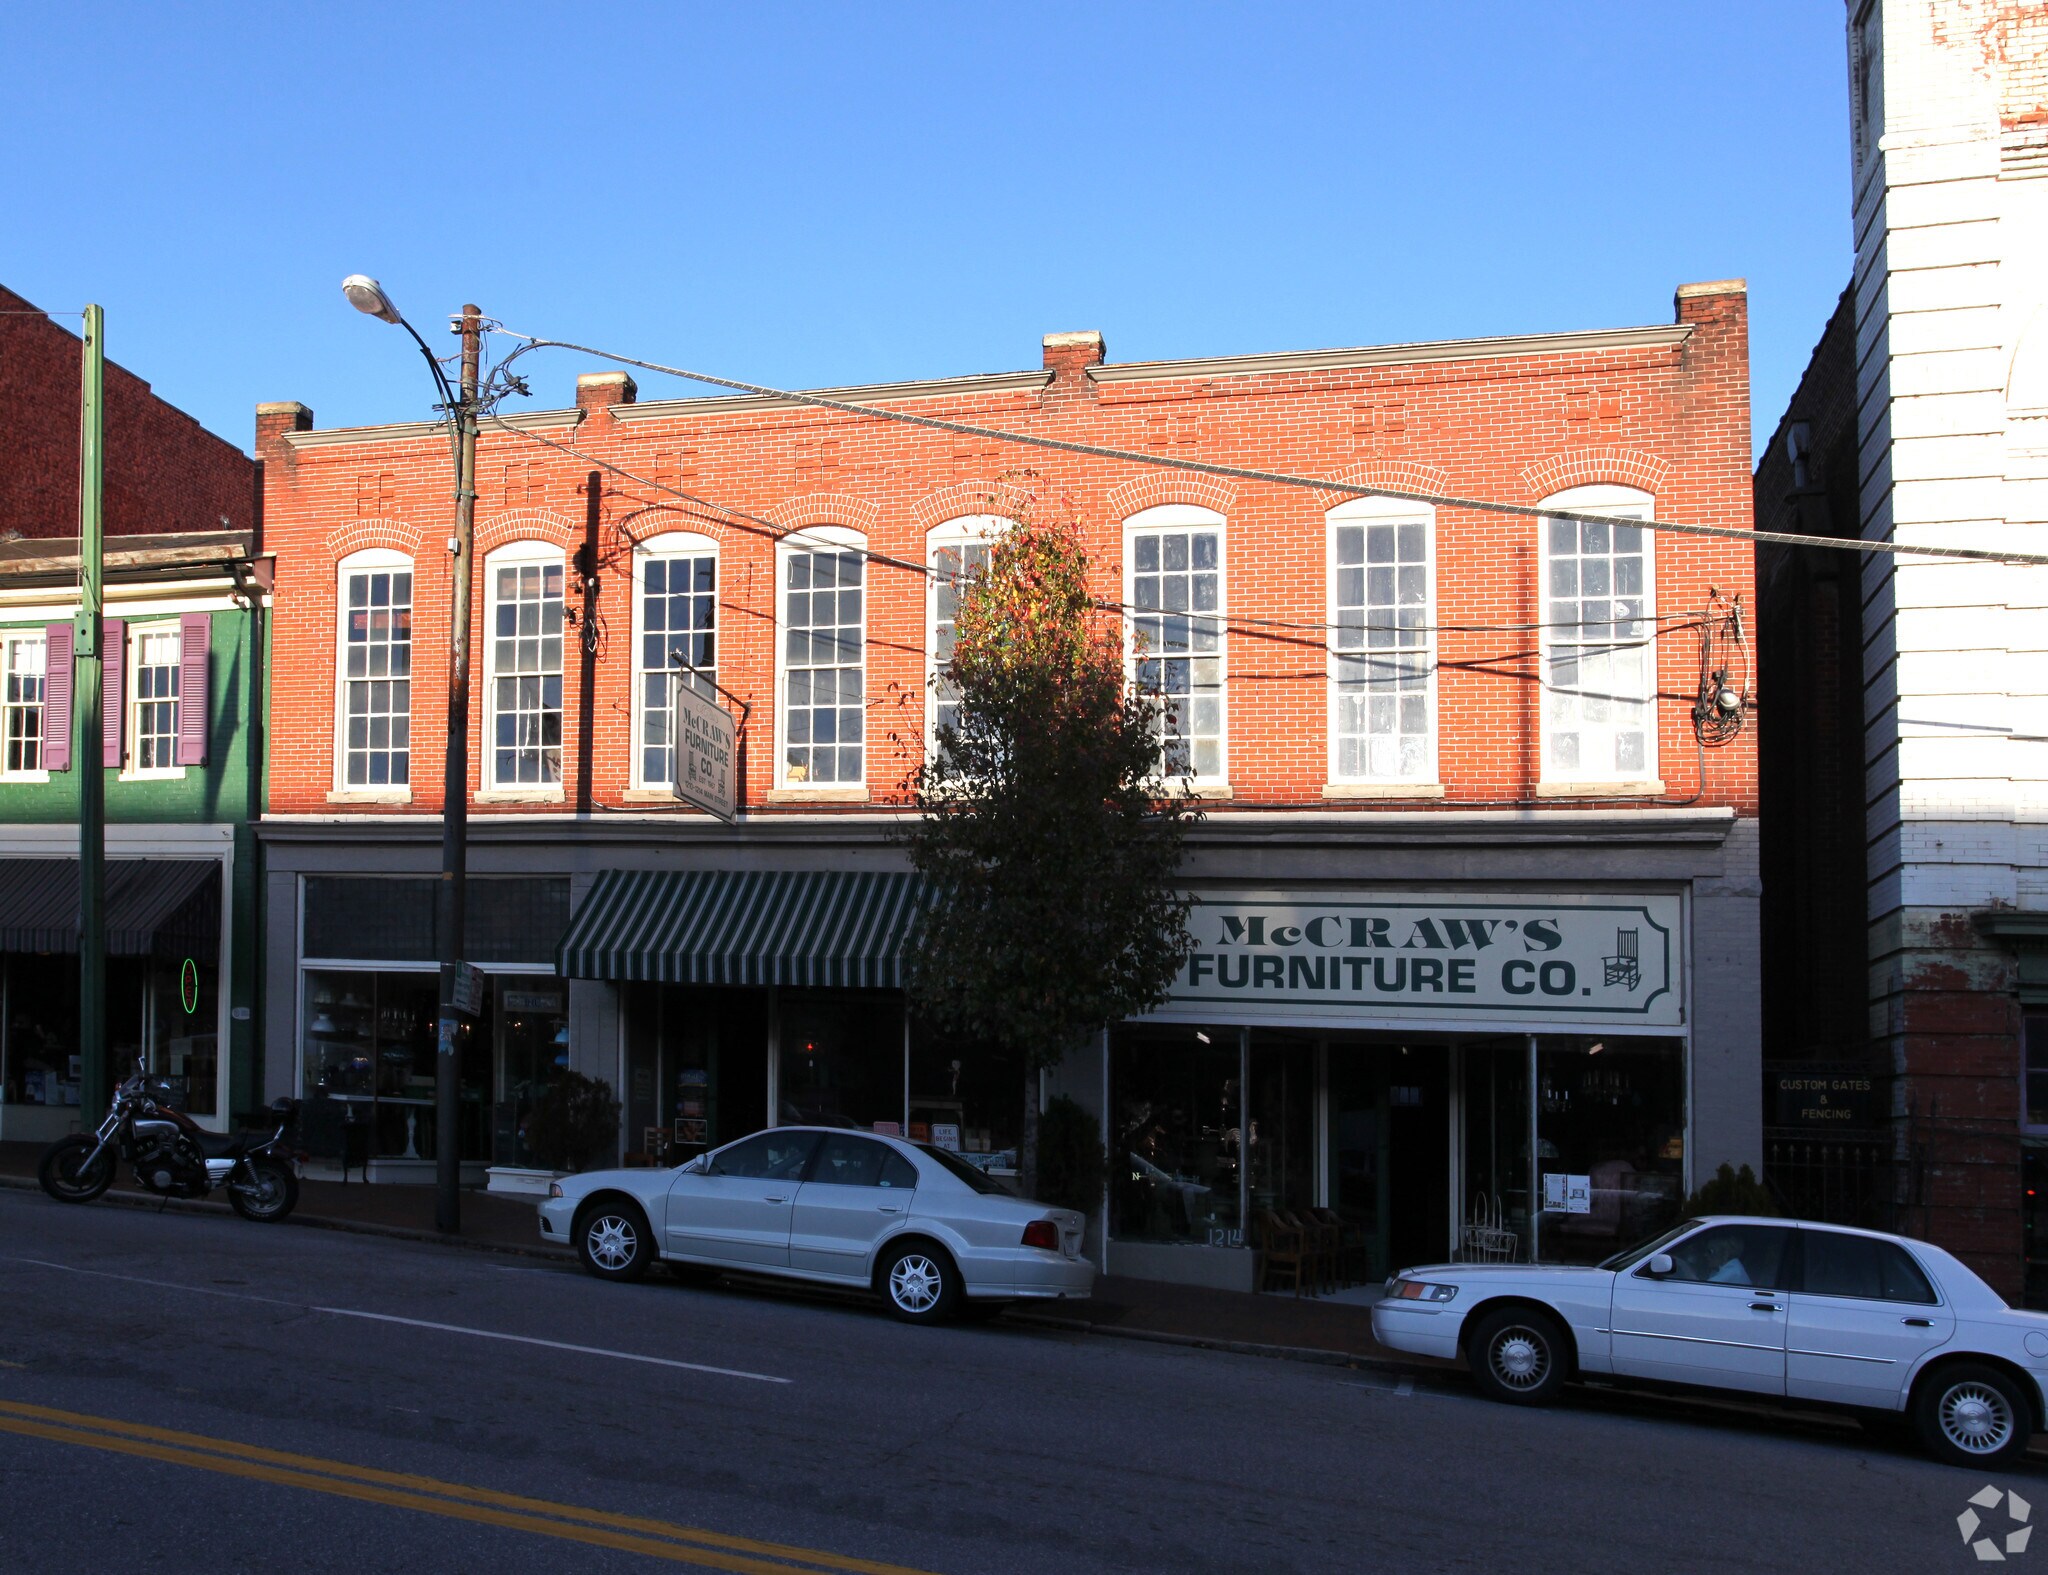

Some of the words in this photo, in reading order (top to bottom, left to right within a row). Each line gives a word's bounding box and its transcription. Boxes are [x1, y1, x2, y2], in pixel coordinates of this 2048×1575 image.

[683, 706, 731, 750] McCRAW'S
[685, 728, 729, 768] FURNITURE
[700, 757, 715, 779] CO.
[703, 789, 714, 801] MAIN
[714, 795, 728, 808] STREET
[1215, 914, 1563, 953] McCRAW'S
[1188, 953, 1477, 994] FURNITURE
[1501, 959, 1592, 996] CO.
[1780, 1080, 1827, 1090] CUSTOM
[1831, 1080, 1871, 1091] GATES
[1820, 1094, 1829, 1105] &
[1801, 1108, 1852, 1120] FENCING
[1208, 1228, 1244, 1246] 1214
